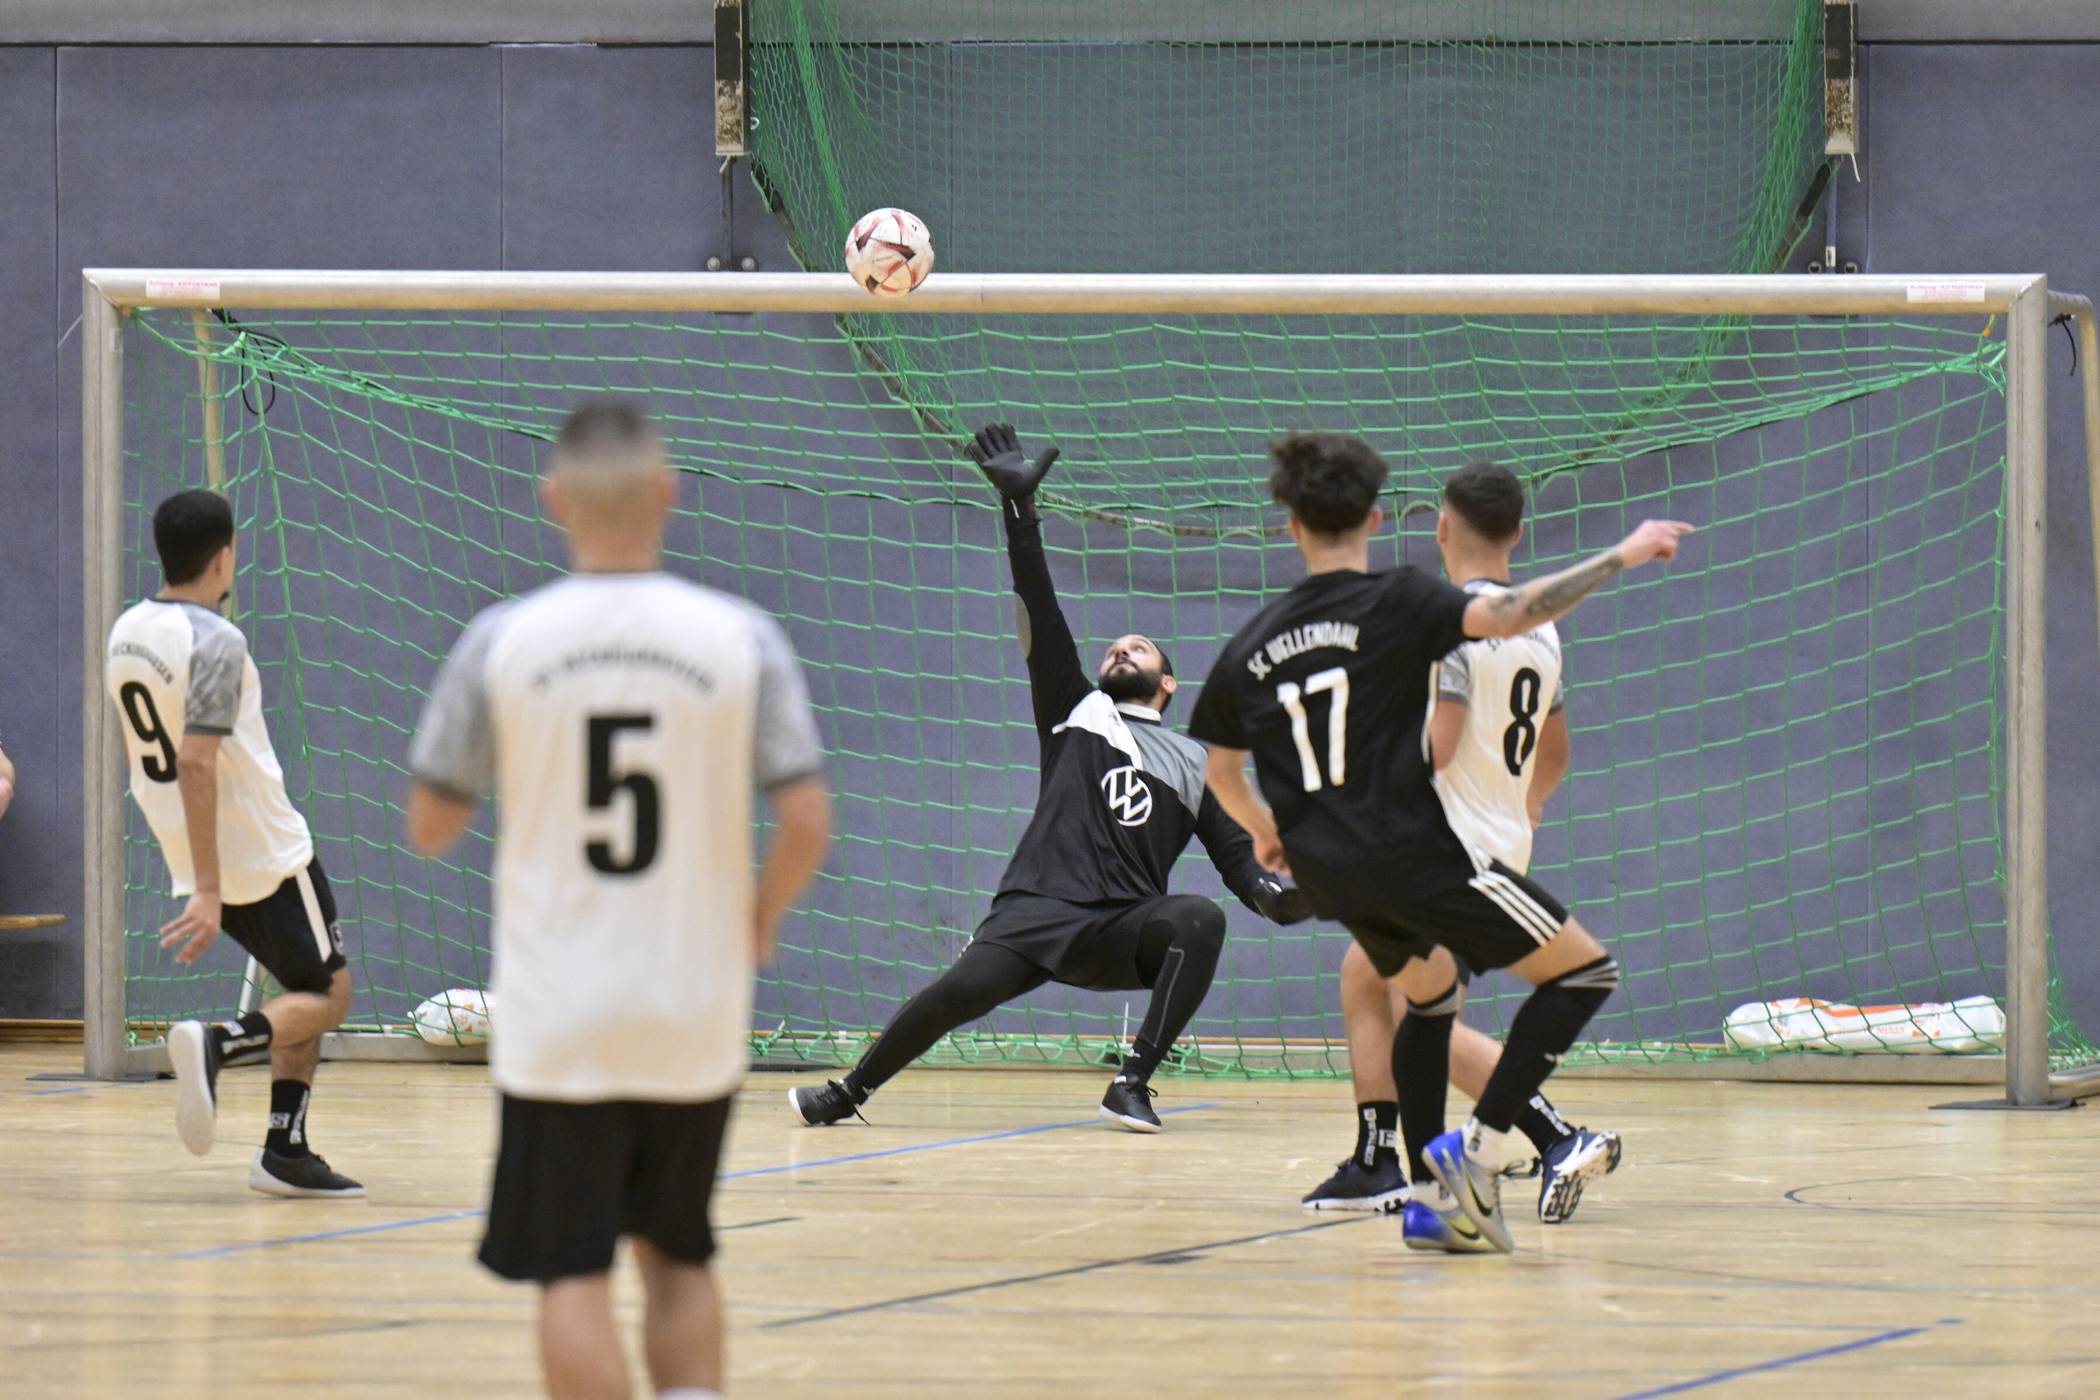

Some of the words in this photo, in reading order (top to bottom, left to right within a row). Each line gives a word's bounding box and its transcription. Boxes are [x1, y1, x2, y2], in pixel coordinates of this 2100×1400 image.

[1246, 650, 1273, 681] SC
[119, 681, 178, 783] 9
[1276, 666, 1350, 793] 17
[1503, 667, 1541, 777] 8
[584, 712, 661, 878] 5
